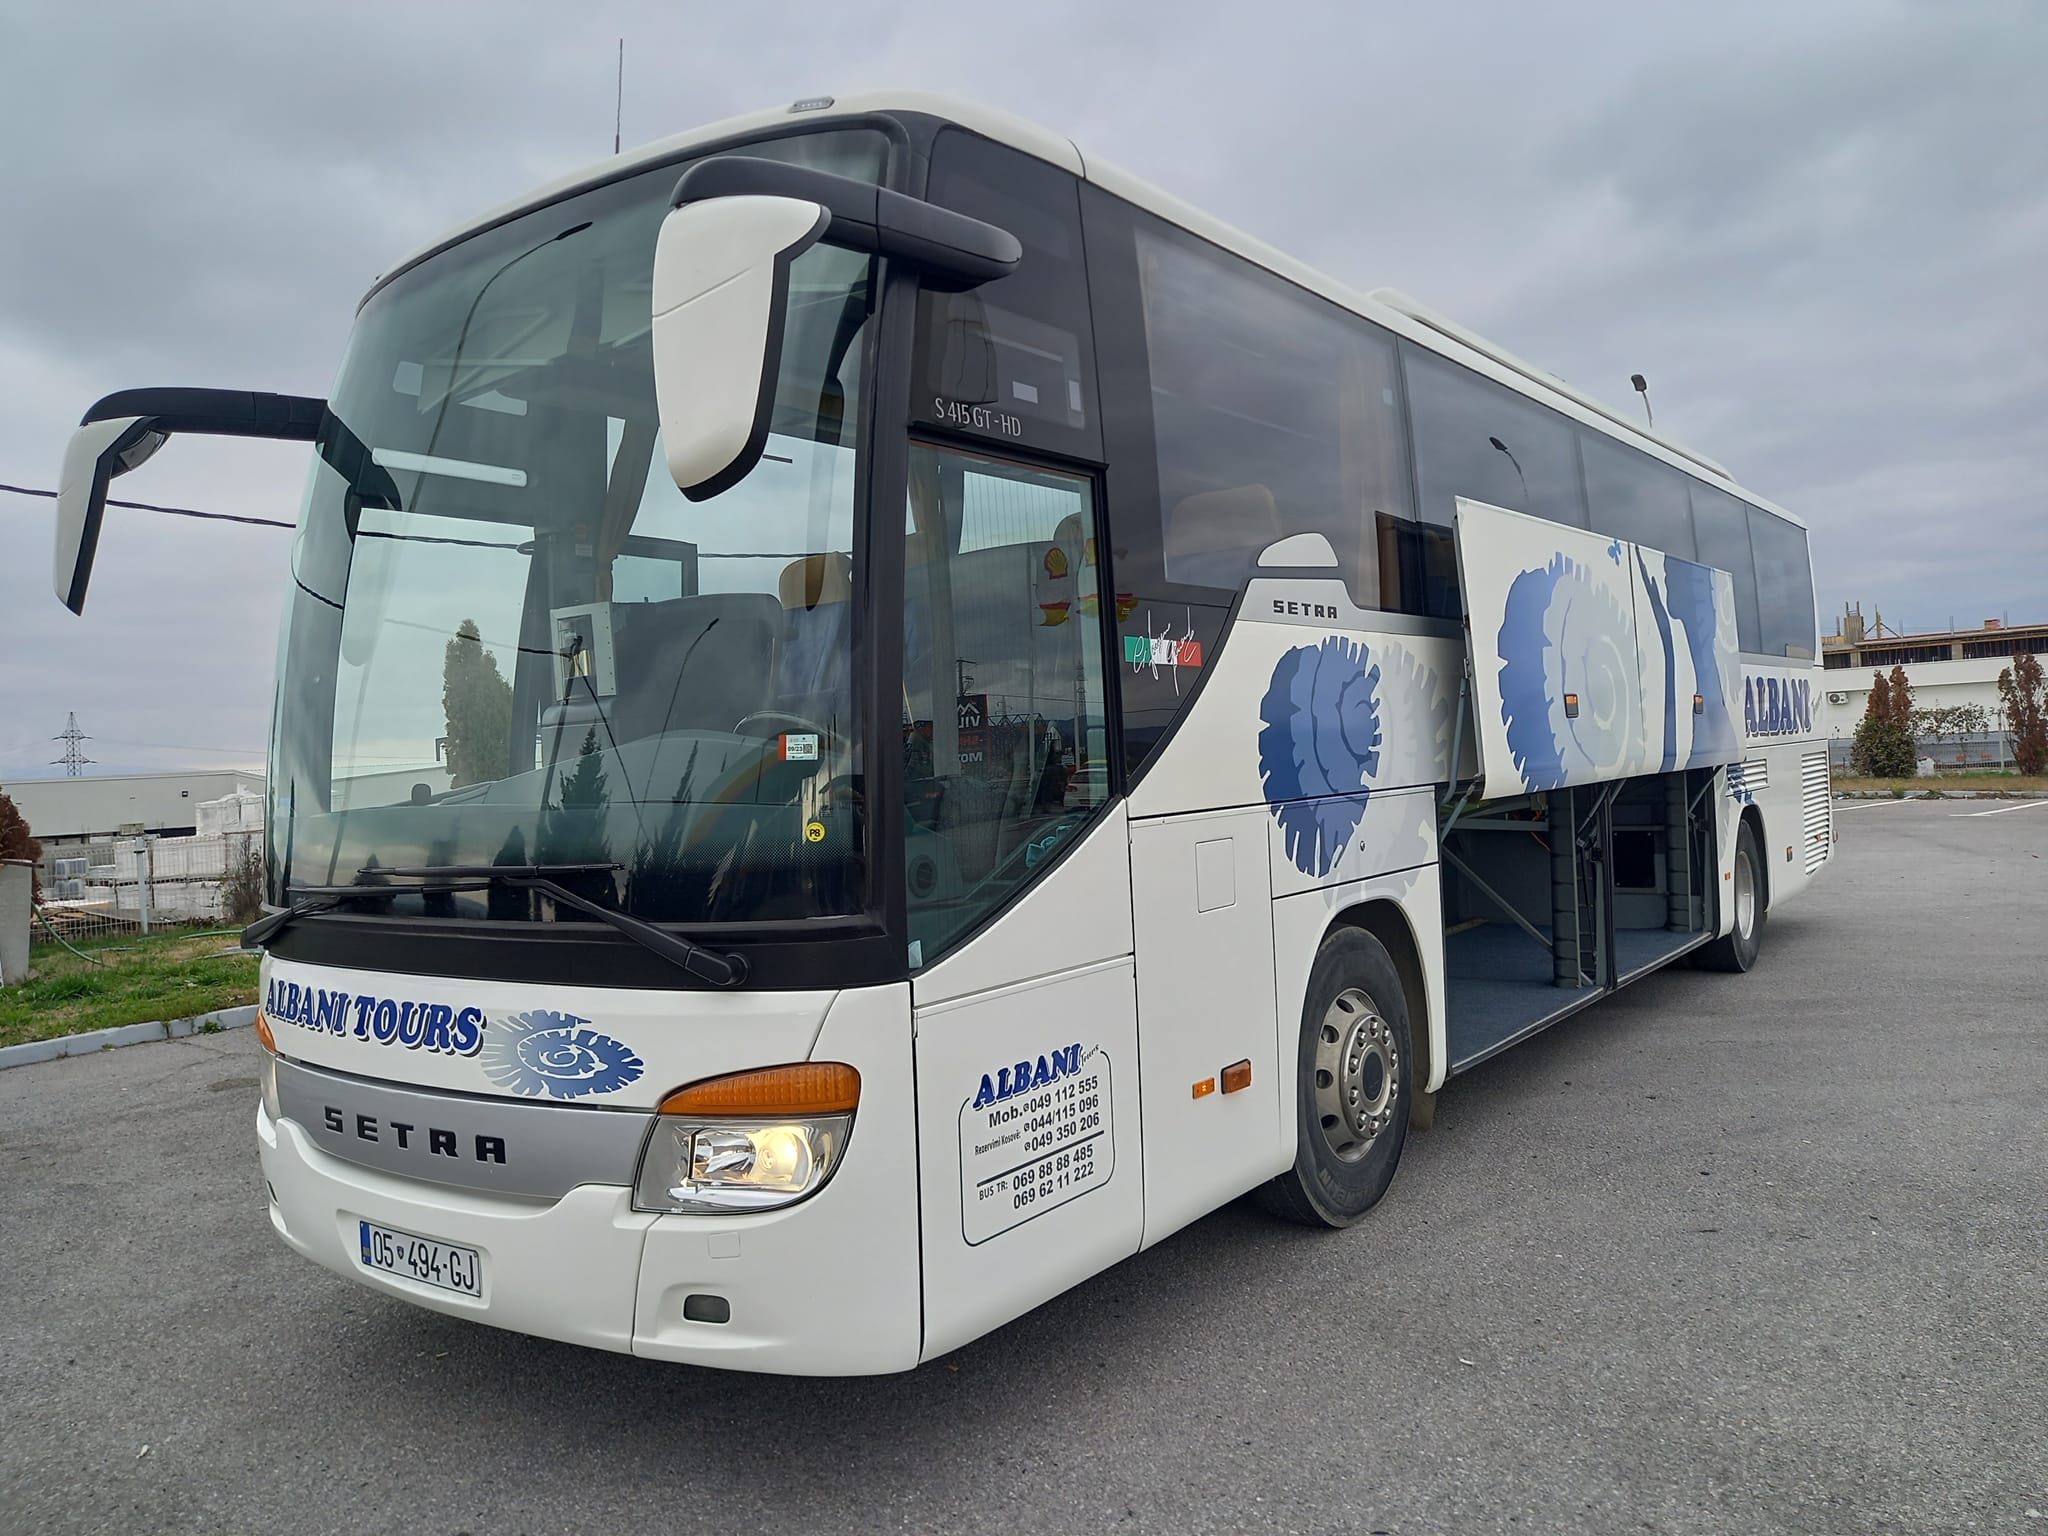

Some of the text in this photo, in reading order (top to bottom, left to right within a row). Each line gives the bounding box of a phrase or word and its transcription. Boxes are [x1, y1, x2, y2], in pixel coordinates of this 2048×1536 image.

[934, 397, 945, 419] S
[947, 401, 971, 425] 415
[1273, 599, 1338, 619] SETRA
[1745, 675, 1811, 737] ALBANI
[265, 977, 486, 1057] ALBANI TOURS
[972, 1043, 1082, 1110] ALBANI
[988, 1075, 1098, 1128] Mob. 049 112 555
[324, 1105, 507, 1164] SETRA
[1030, 1094, 1099, 1132] 044/115 096
[1031, 1112, 1100, 1151] 049 350 206
[979, 1143, 1093, 1200] BUS TR: 069 88 88 485
[1013, 1161, 1094, 1209] 069 62 11 222
[373, 1231, 394, 1268] 05
